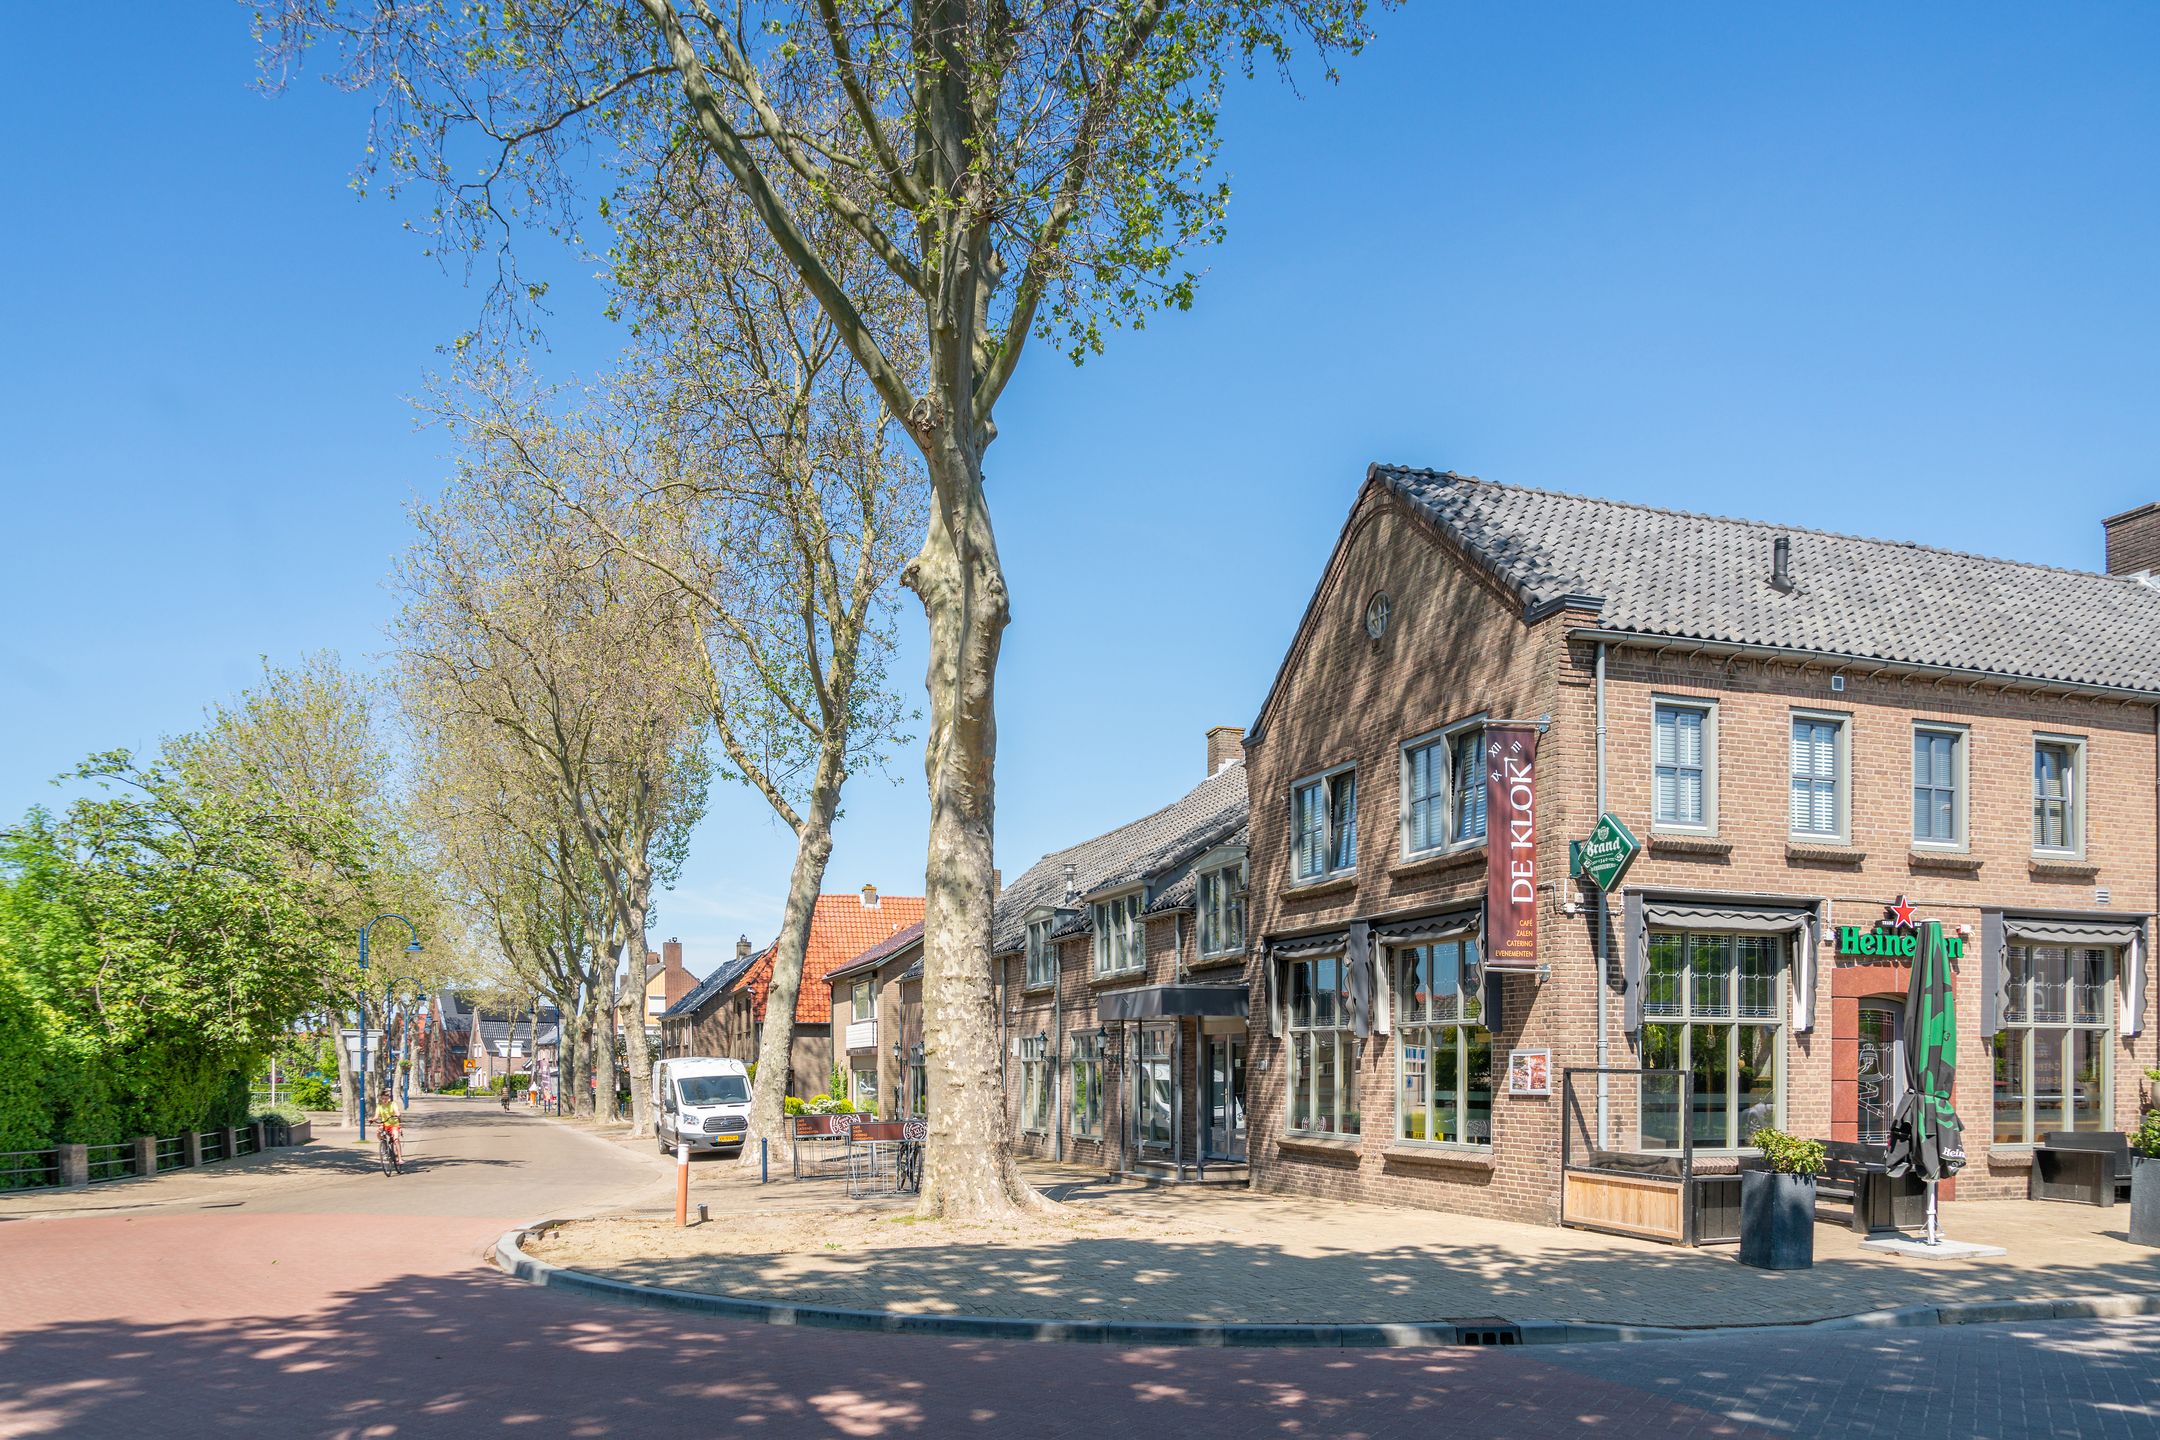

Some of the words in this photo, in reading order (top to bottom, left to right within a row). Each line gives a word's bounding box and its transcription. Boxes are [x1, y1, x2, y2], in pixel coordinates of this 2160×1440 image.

[1488, 741, 1502, 758] XII
[1510, 762, 1533, 849] KLOK
[1586, 837, 1621, 857] Brand
[1511, 860, 1534, 905] DE
[1519, 918, 1533, 927] CAFÉ
[1840, 926, 1963, 959] Heinen
[1495, 950, 1534, 958] EVENEMENTEN
